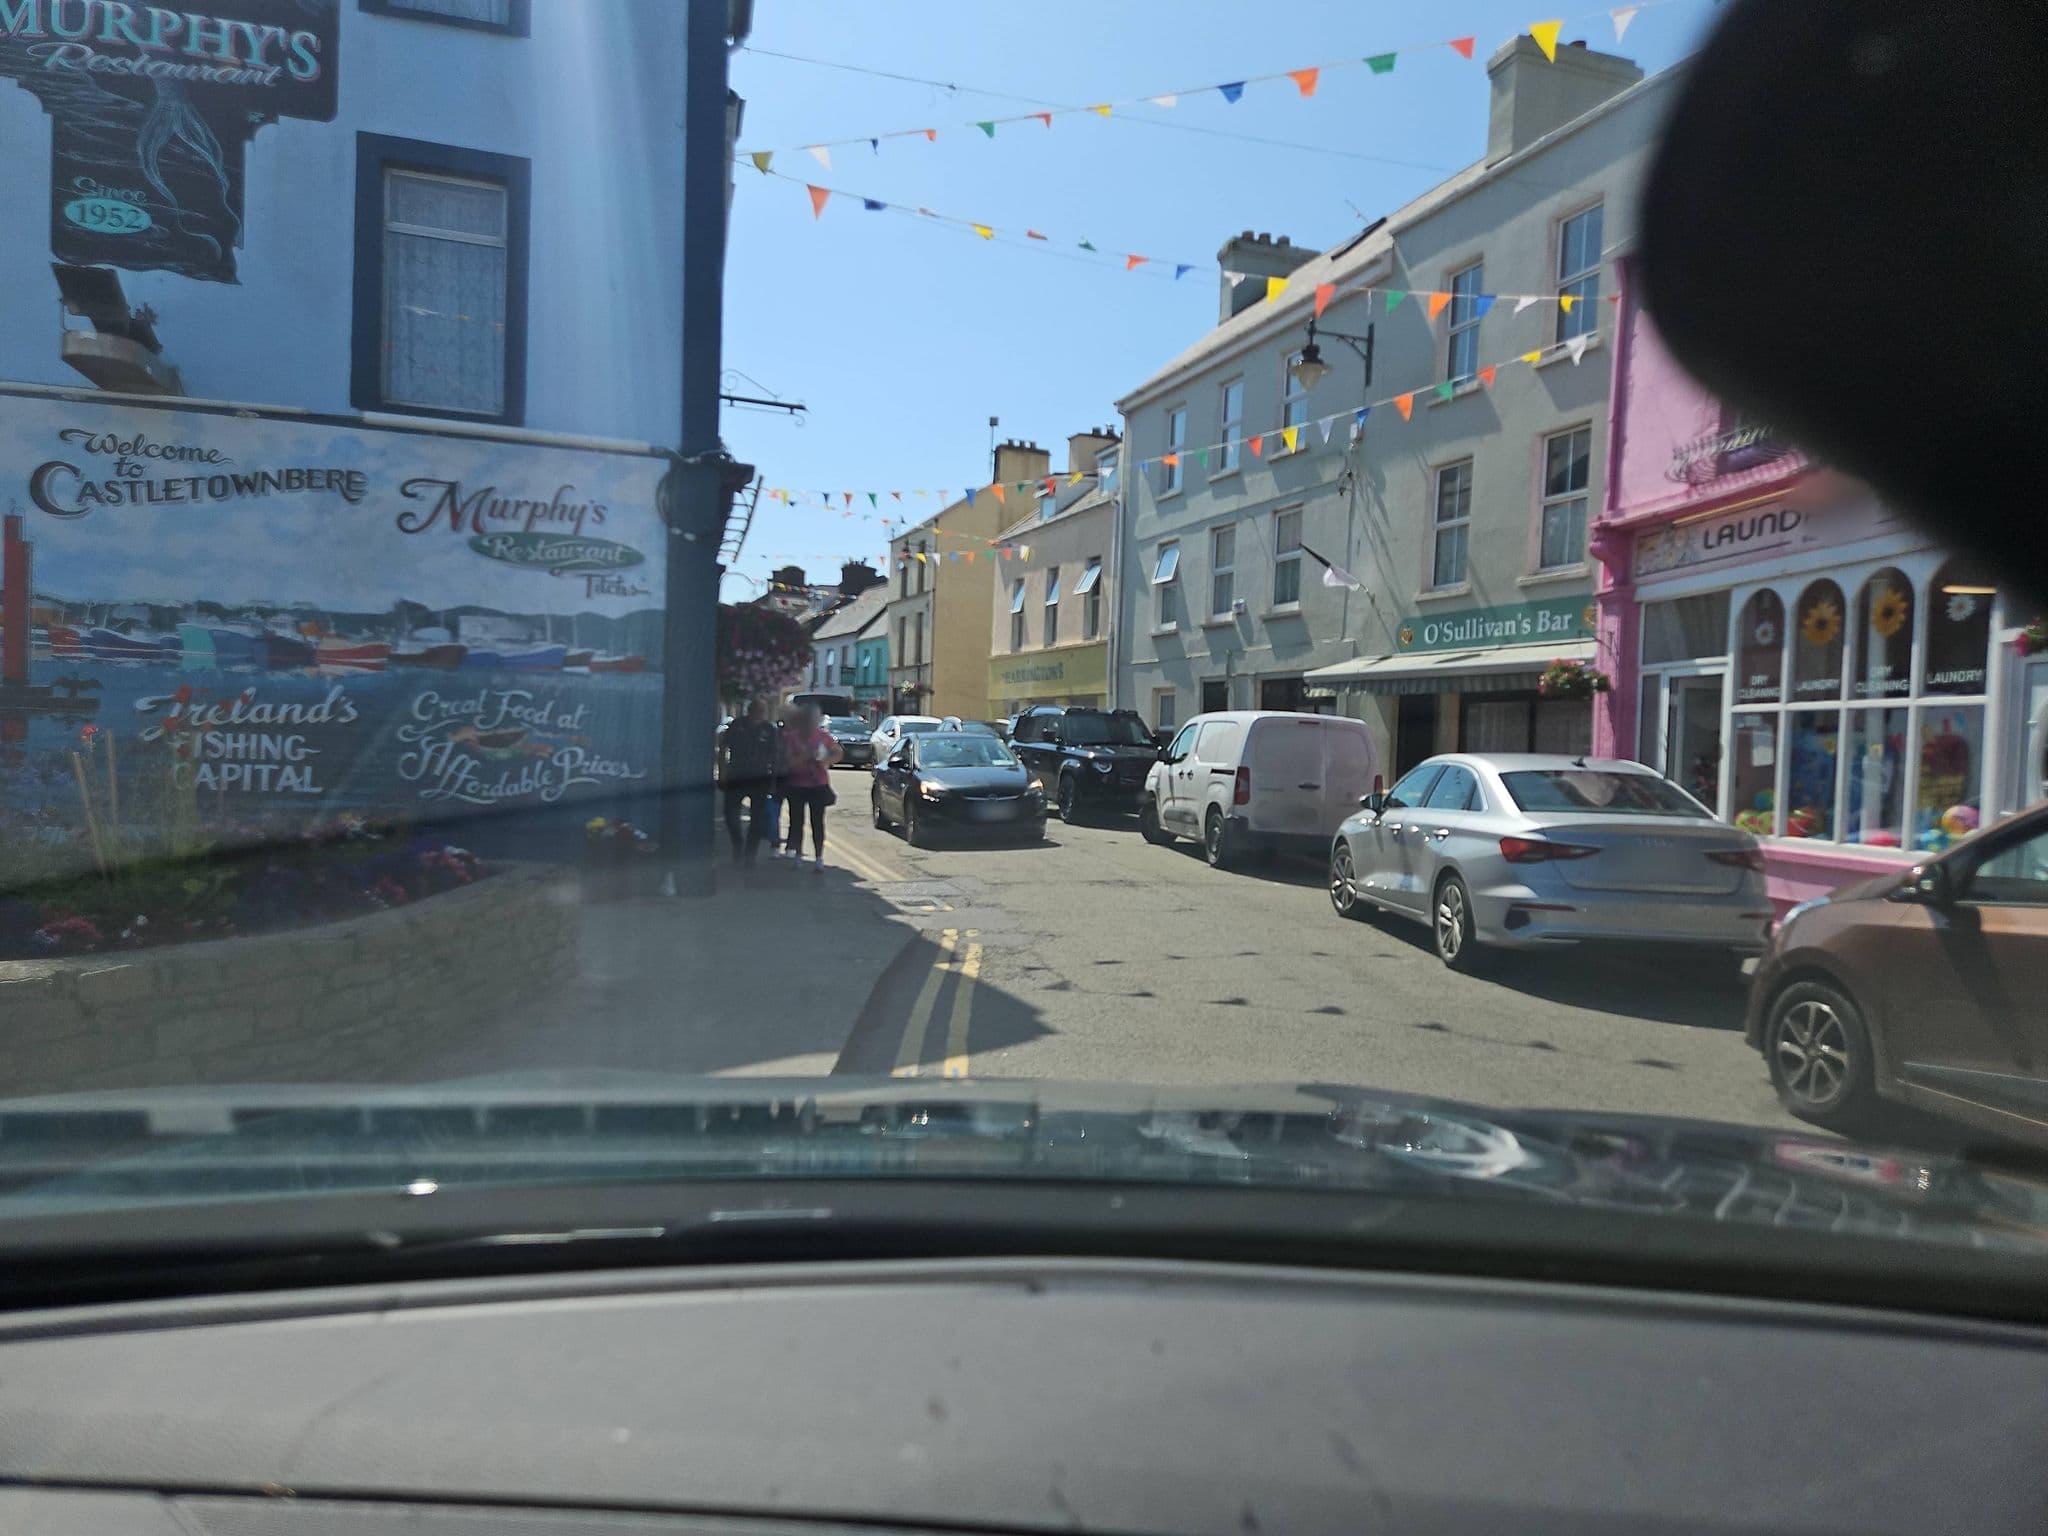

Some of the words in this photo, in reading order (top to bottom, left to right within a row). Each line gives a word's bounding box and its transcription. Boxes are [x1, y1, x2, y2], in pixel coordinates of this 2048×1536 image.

[0, 0, 321, 81] MURPHY'S
[27, 42, 284, 87] Restaurant
[73, 176, 147, 202] Since
[76, 203, 144, 231] 1952
[59, 428, 236, 466] Welcome
[113, 457, 147, 479] to
[396, 477, 608, 535] Murphy's
[1703, 509, 1810, 550] LAUND
[482, 535, 625, 563] Restaurant
[1424, 612, 1531, 644] O'Sullivan's
[1537, 609, 1573, 634] Bar
[1751, 675, 1769, 685] DRY
[1926, 669, 1984, 684] LAUNDRY
[135, 686, 359, 742] Ireland's
[557, 704, 591, 729] at
[540, 747, 647, 802] Prices
